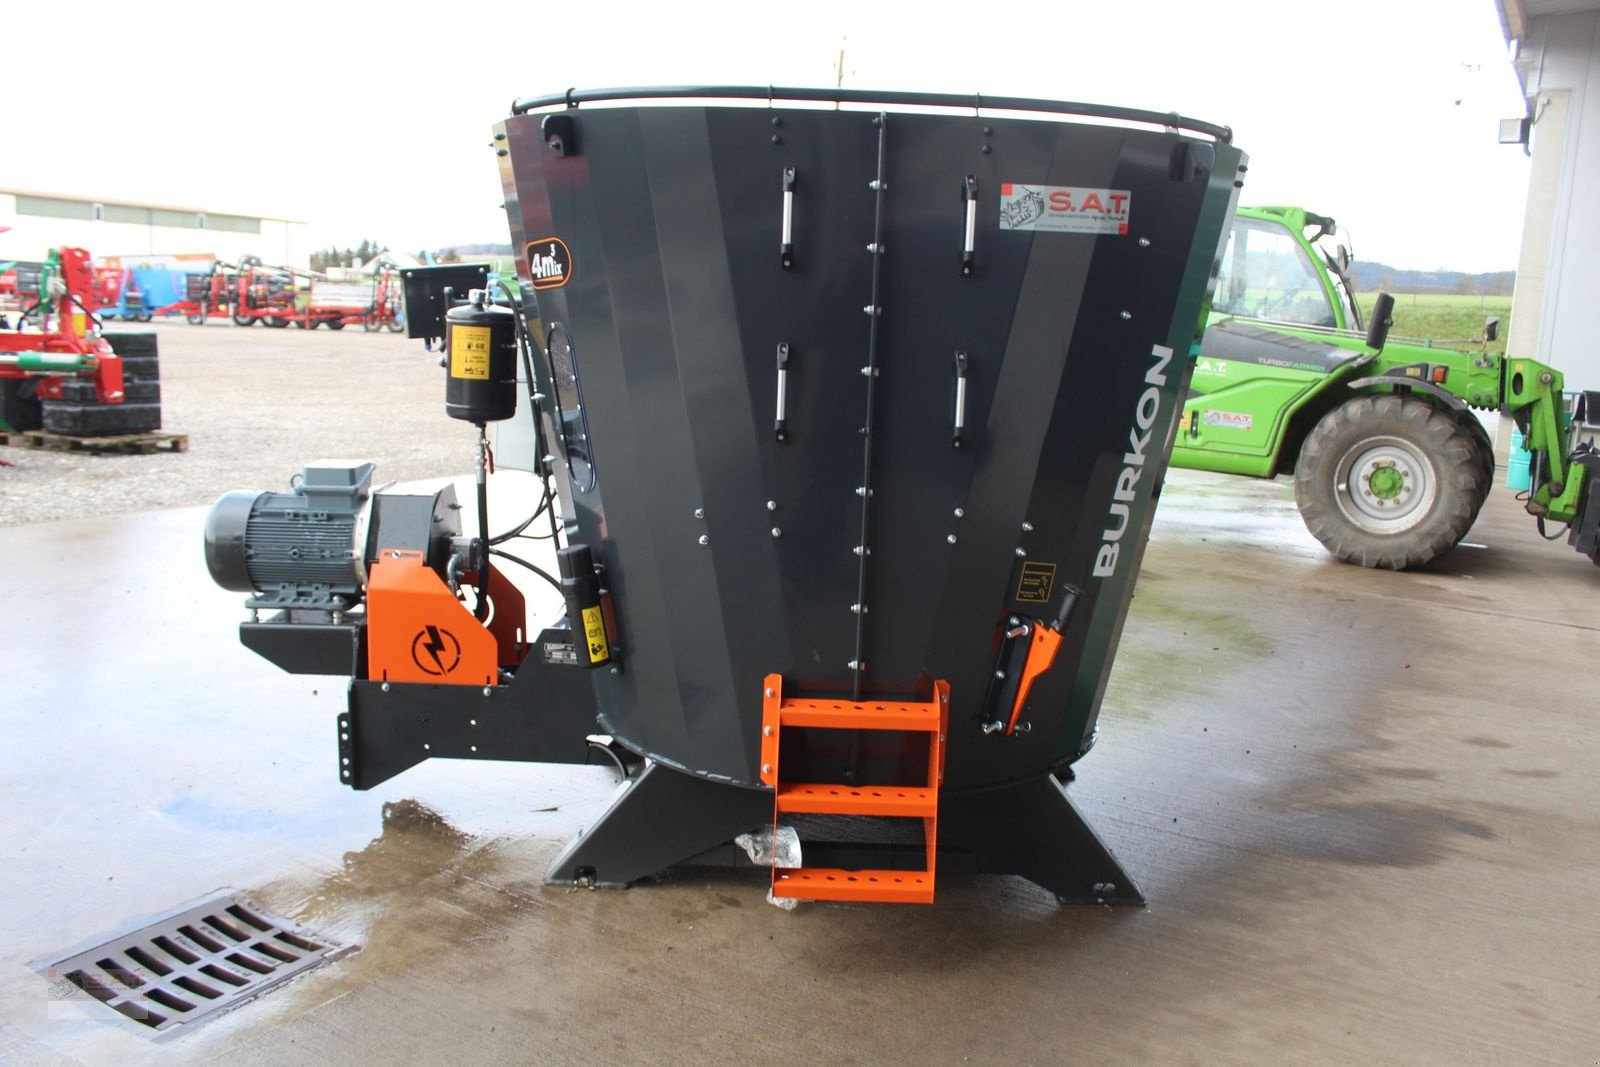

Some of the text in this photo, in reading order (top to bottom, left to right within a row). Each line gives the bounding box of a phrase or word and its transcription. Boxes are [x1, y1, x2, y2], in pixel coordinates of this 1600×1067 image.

[1049, 191, 1128, 214] S.A.T.
[1258, 357, 1326, 372] TURBOFARMER
[1092, 344, 1174, 577] BURKON
